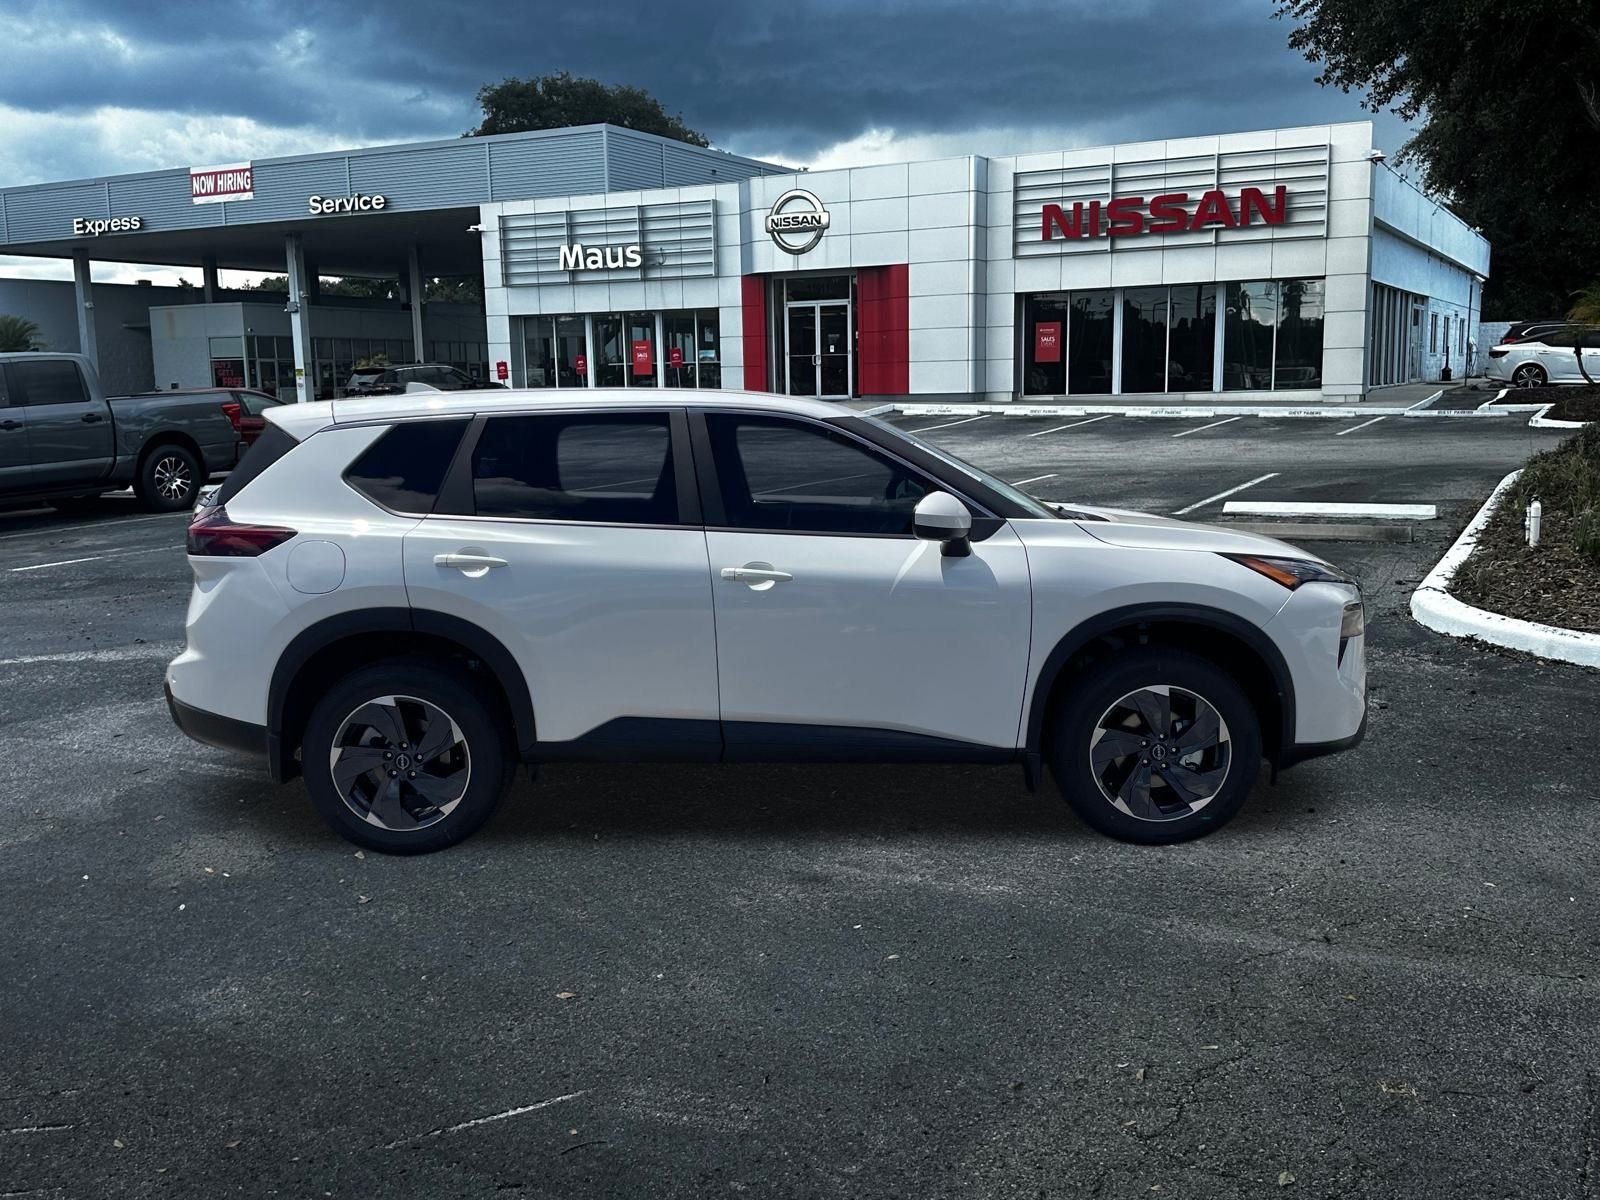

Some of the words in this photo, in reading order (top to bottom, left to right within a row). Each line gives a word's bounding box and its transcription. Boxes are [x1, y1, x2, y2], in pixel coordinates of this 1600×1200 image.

[193, 174, 215, 195] NOW
[217, 171, 251, 192] HIRING
[309, 193, 385, 214] Service
[1042, 185, 1287, 241] NISSAN
[73, 216, 141, 236] Express
[770, 214, 822, 228] NISSAN
[559, 243, 642, 271] Maus
